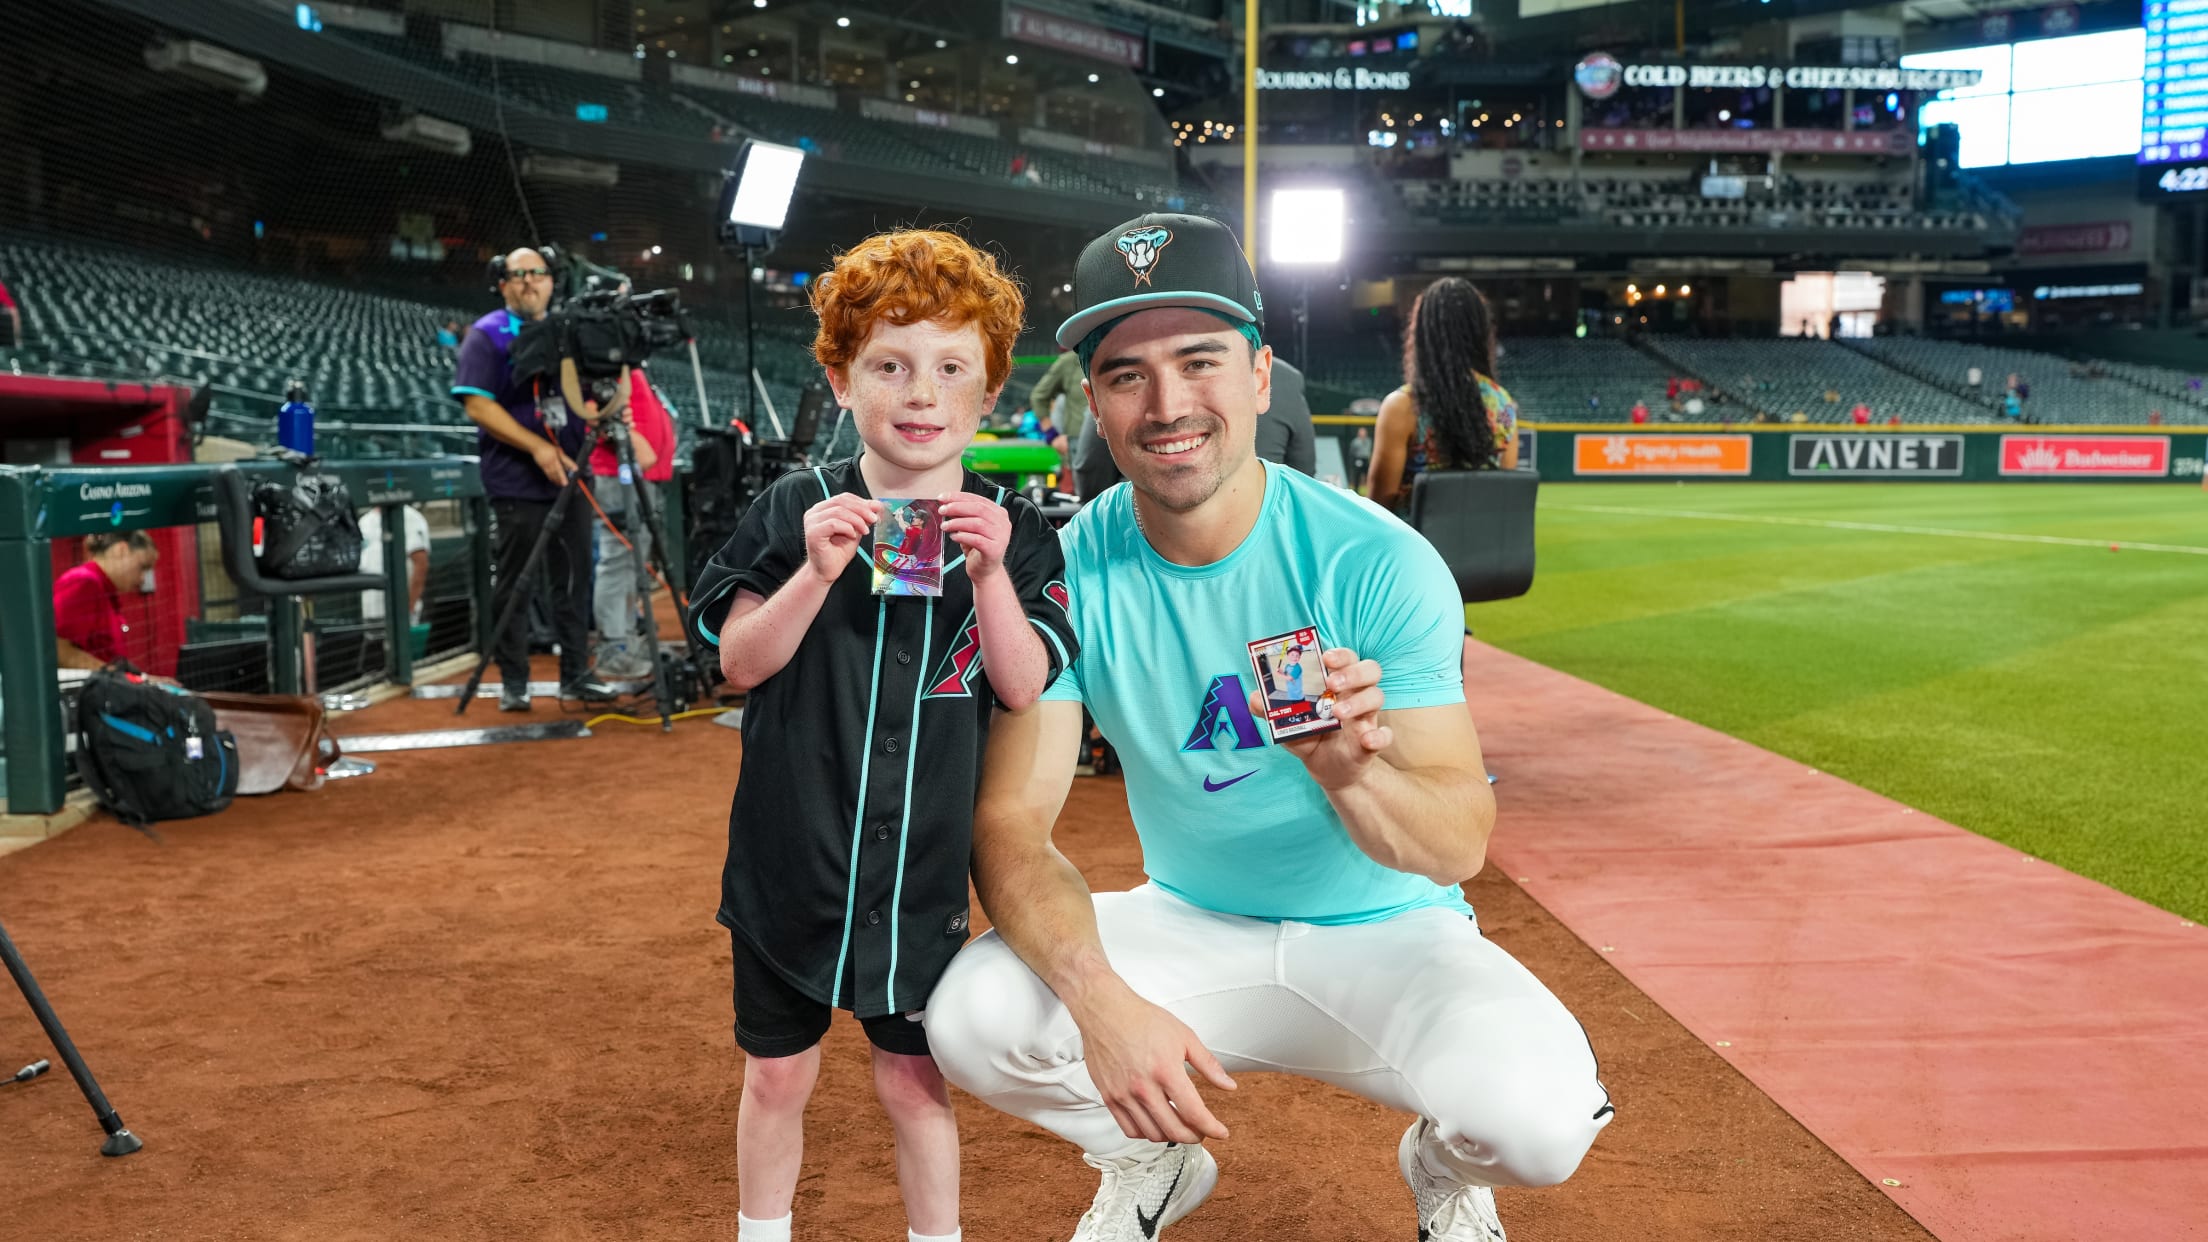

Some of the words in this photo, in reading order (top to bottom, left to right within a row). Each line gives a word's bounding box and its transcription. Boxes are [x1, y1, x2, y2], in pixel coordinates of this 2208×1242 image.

[1334, 67, 1352, 89] &
[1624, 65, 1687, 86] COLD
[1690, 65, 1766, 87] BEERS
[1768, 67, 1784, 88] &
[1786, 67, 1982, 89] CHEESEBURGERS
[1634, 444, 1678, 460] Dignity
[1680, 444, 1722, 457] Health
[1808, 439, 1945, 469] AVNET
[2064, 449, 2153, 468] Budweiser
